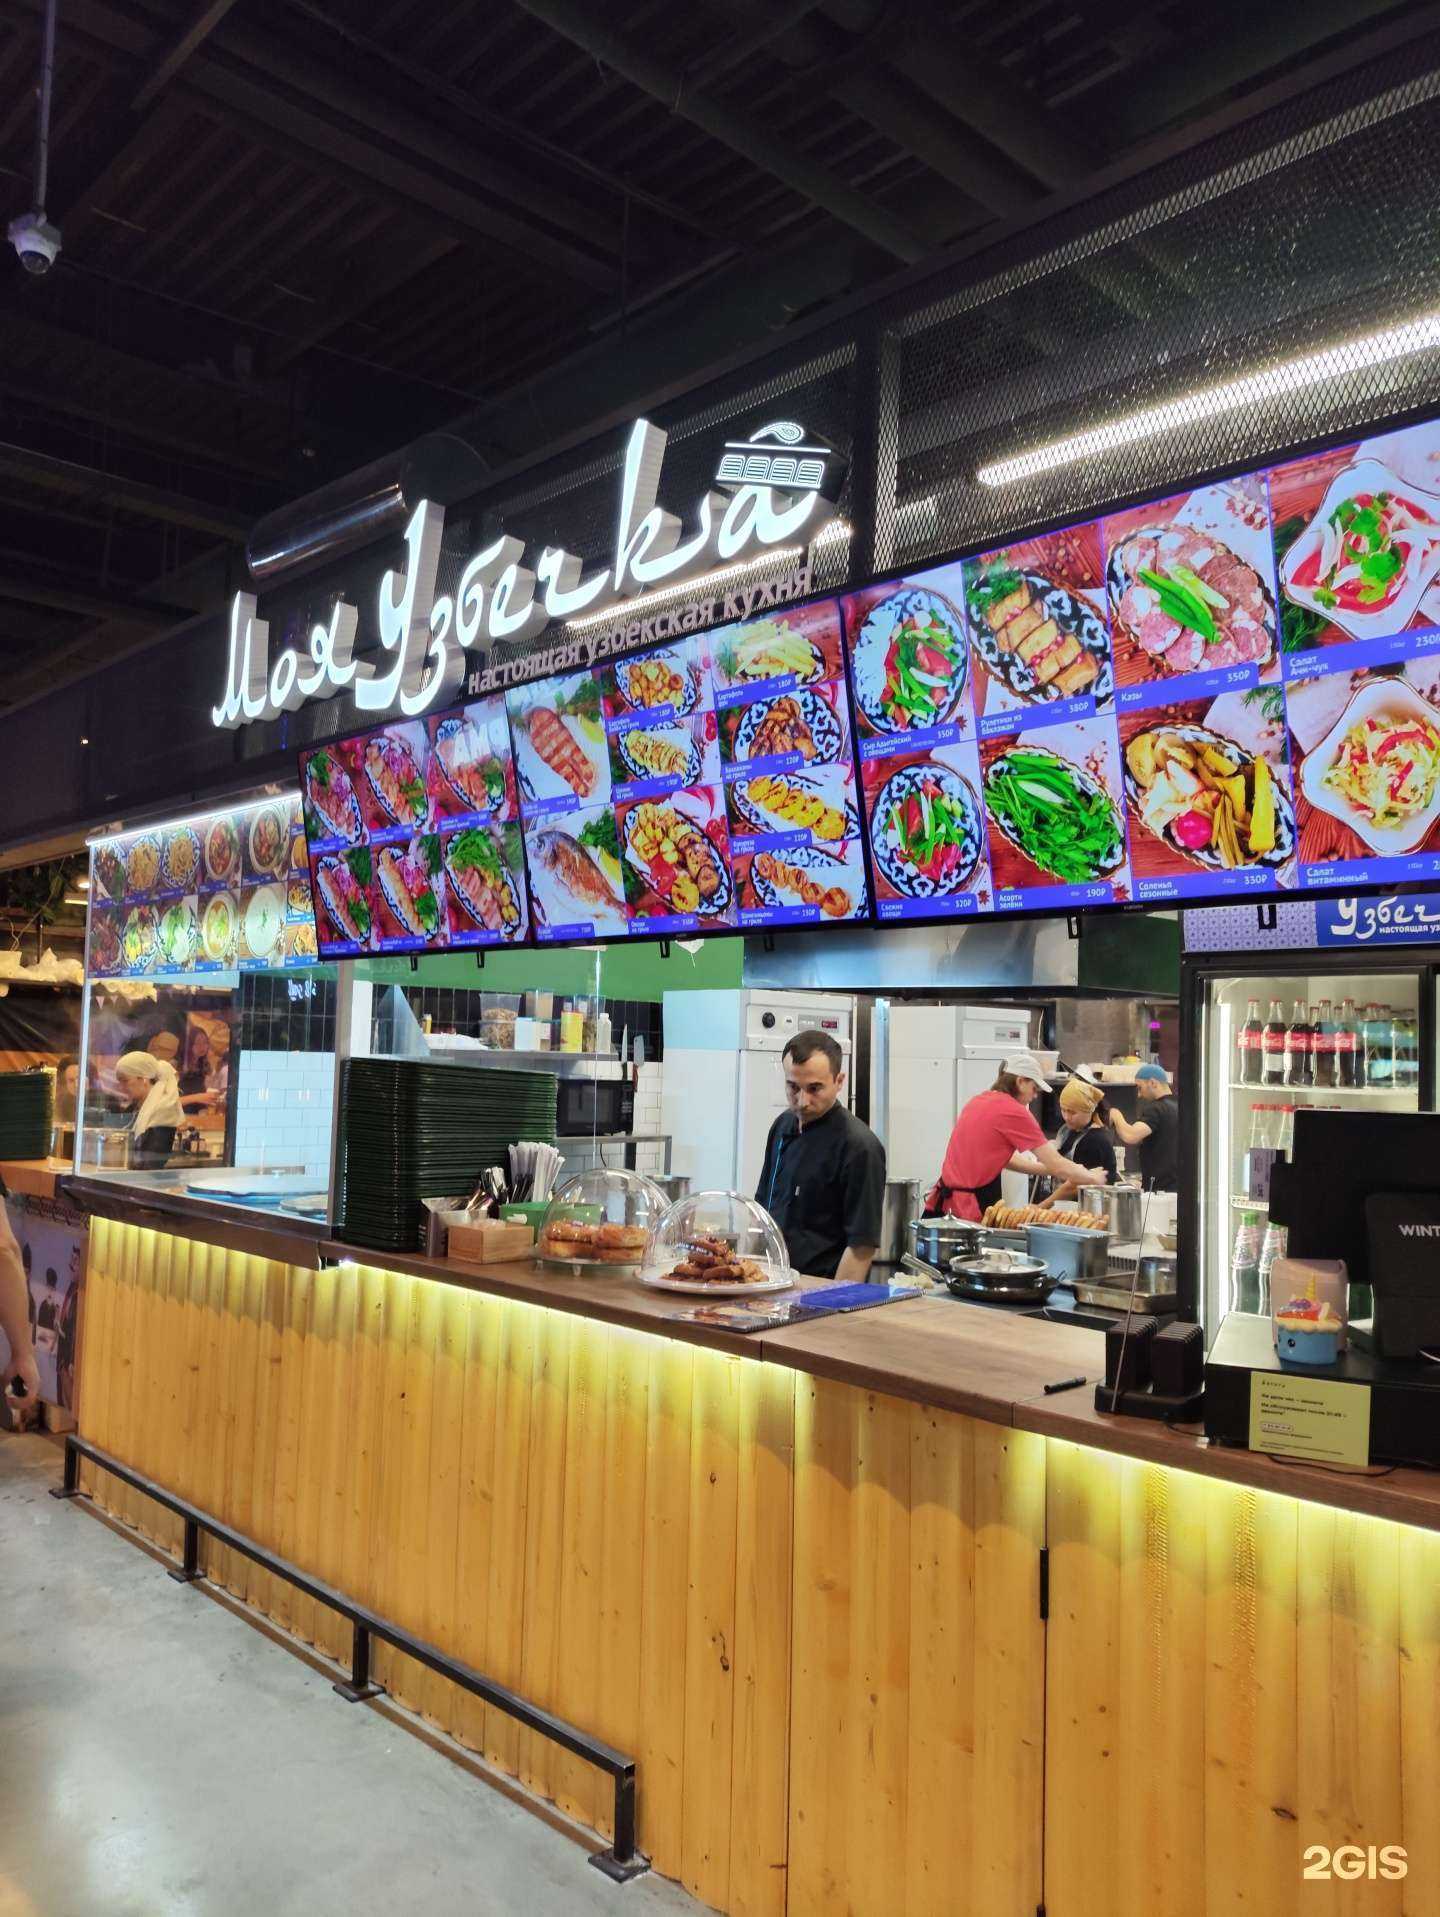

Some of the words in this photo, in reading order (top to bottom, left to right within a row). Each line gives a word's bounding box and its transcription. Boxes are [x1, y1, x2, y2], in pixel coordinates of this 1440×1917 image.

[468, 645, 582, 696] настоящая
[583, 598, 717, 668] узбекская
[722, 567, 813, 622] кухня
[212, 589, 358, 728] Моя
[1289, 655, 1318, 667] Салат
[1121, 692, 1143, 702] Казы
[1306, 867, 1334, 878] Салат
[1307, 872, 1369, 886] витаминный
[1379, 923, 1429, 934] настоящая
[1398, 1224, 1440, 1237] WINT
